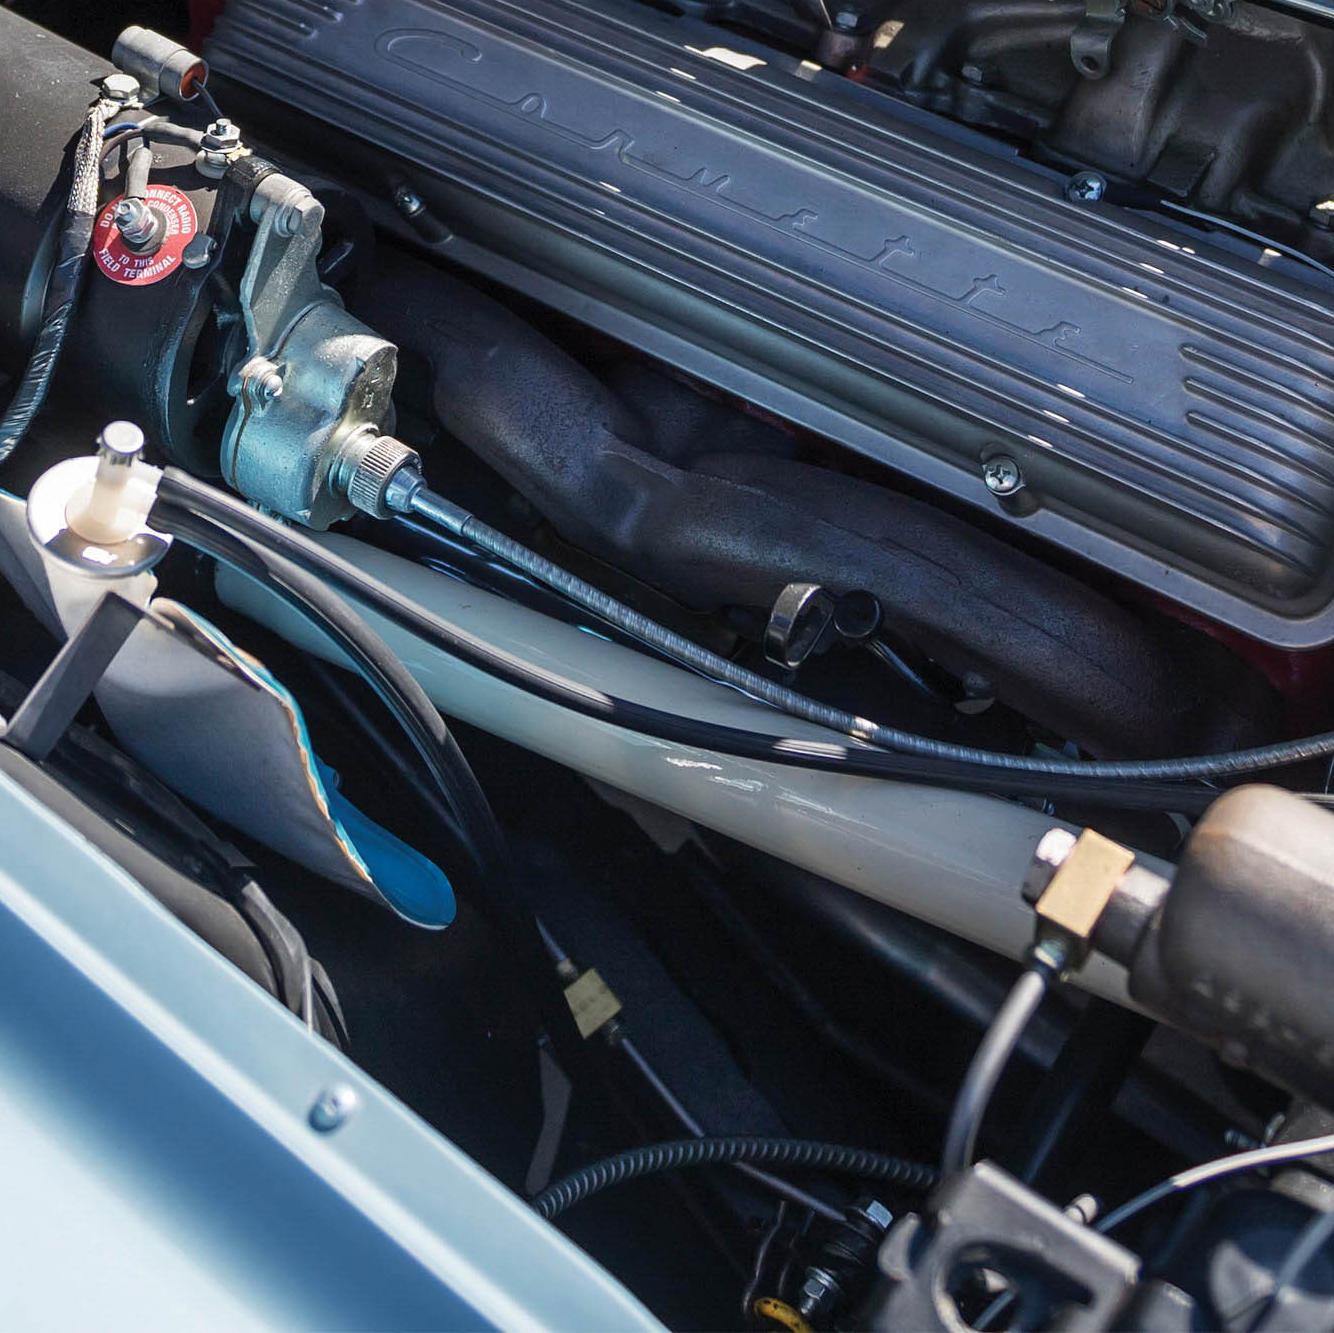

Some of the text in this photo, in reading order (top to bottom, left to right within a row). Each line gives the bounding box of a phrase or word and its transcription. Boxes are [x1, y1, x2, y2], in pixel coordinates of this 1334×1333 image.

[100, 213, 113, 228] DO
[178, 204, 192, 234] RADIO
[148, 200, 179, 235] CONDENSER
[99, 248, 176, 279] FIELD TERMINAL
[118, 254, 154, 267] TO THIS
